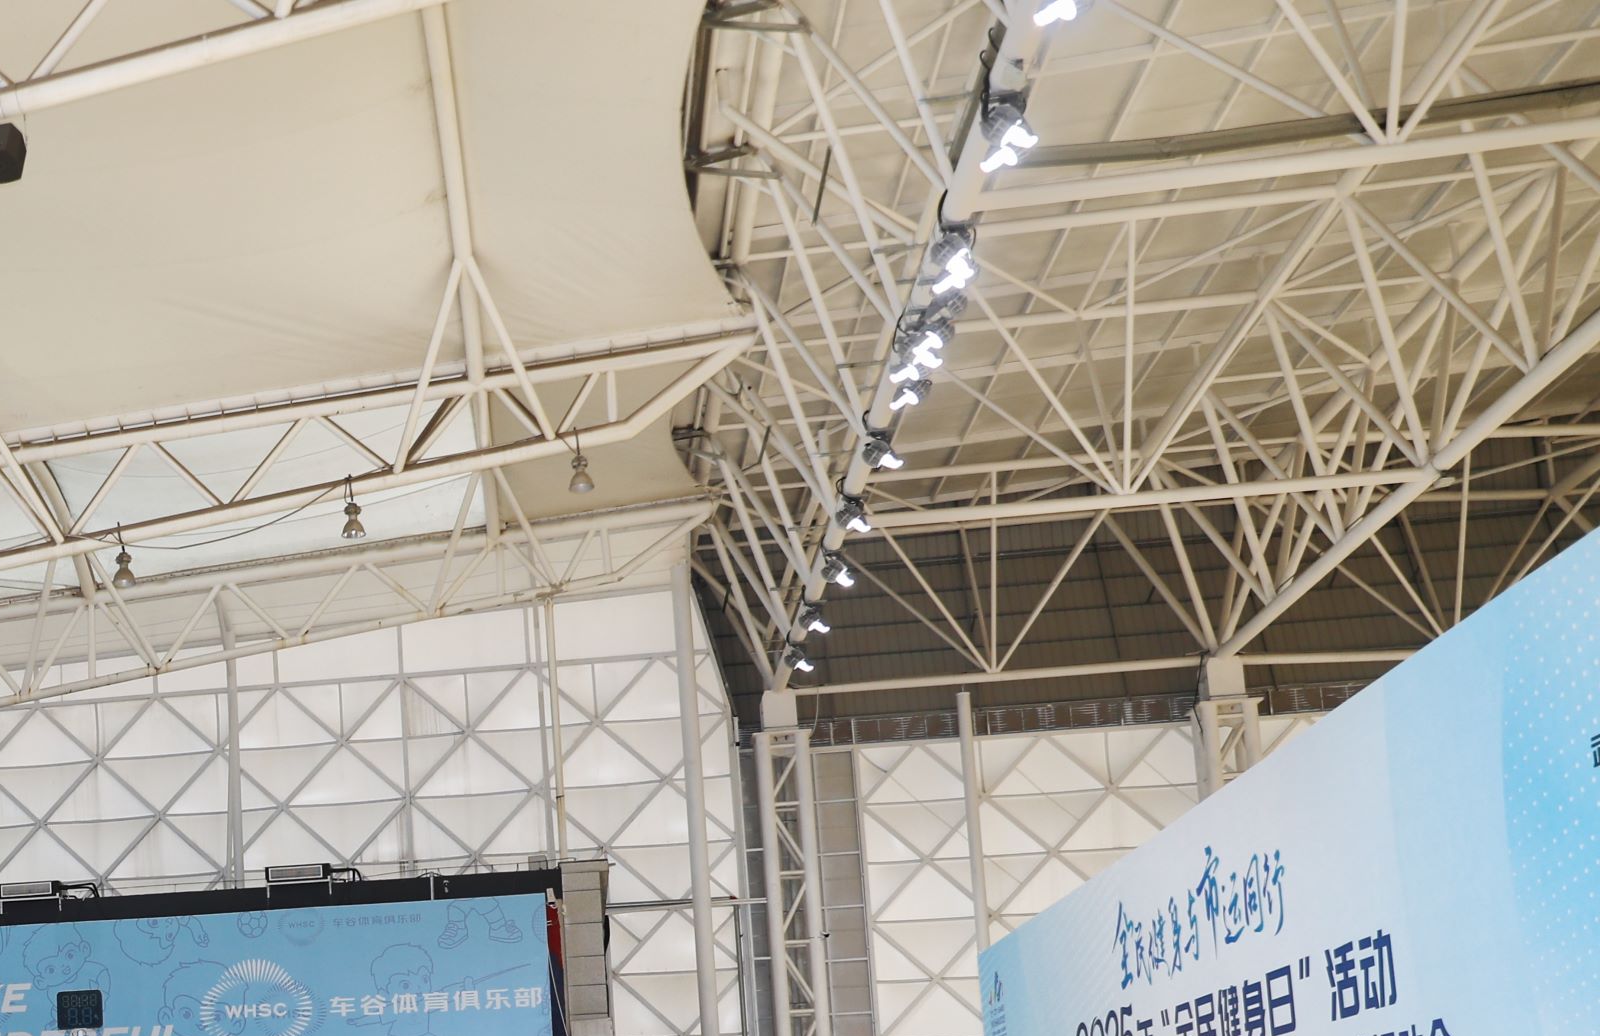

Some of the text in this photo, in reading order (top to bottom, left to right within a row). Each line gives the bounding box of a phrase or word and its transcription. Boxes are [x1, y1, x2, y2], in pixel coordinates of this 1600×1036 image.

[225, 1003, 288, 1018] WHSC
[329, 986, 543, 1017] 车谷体育俱乐部
